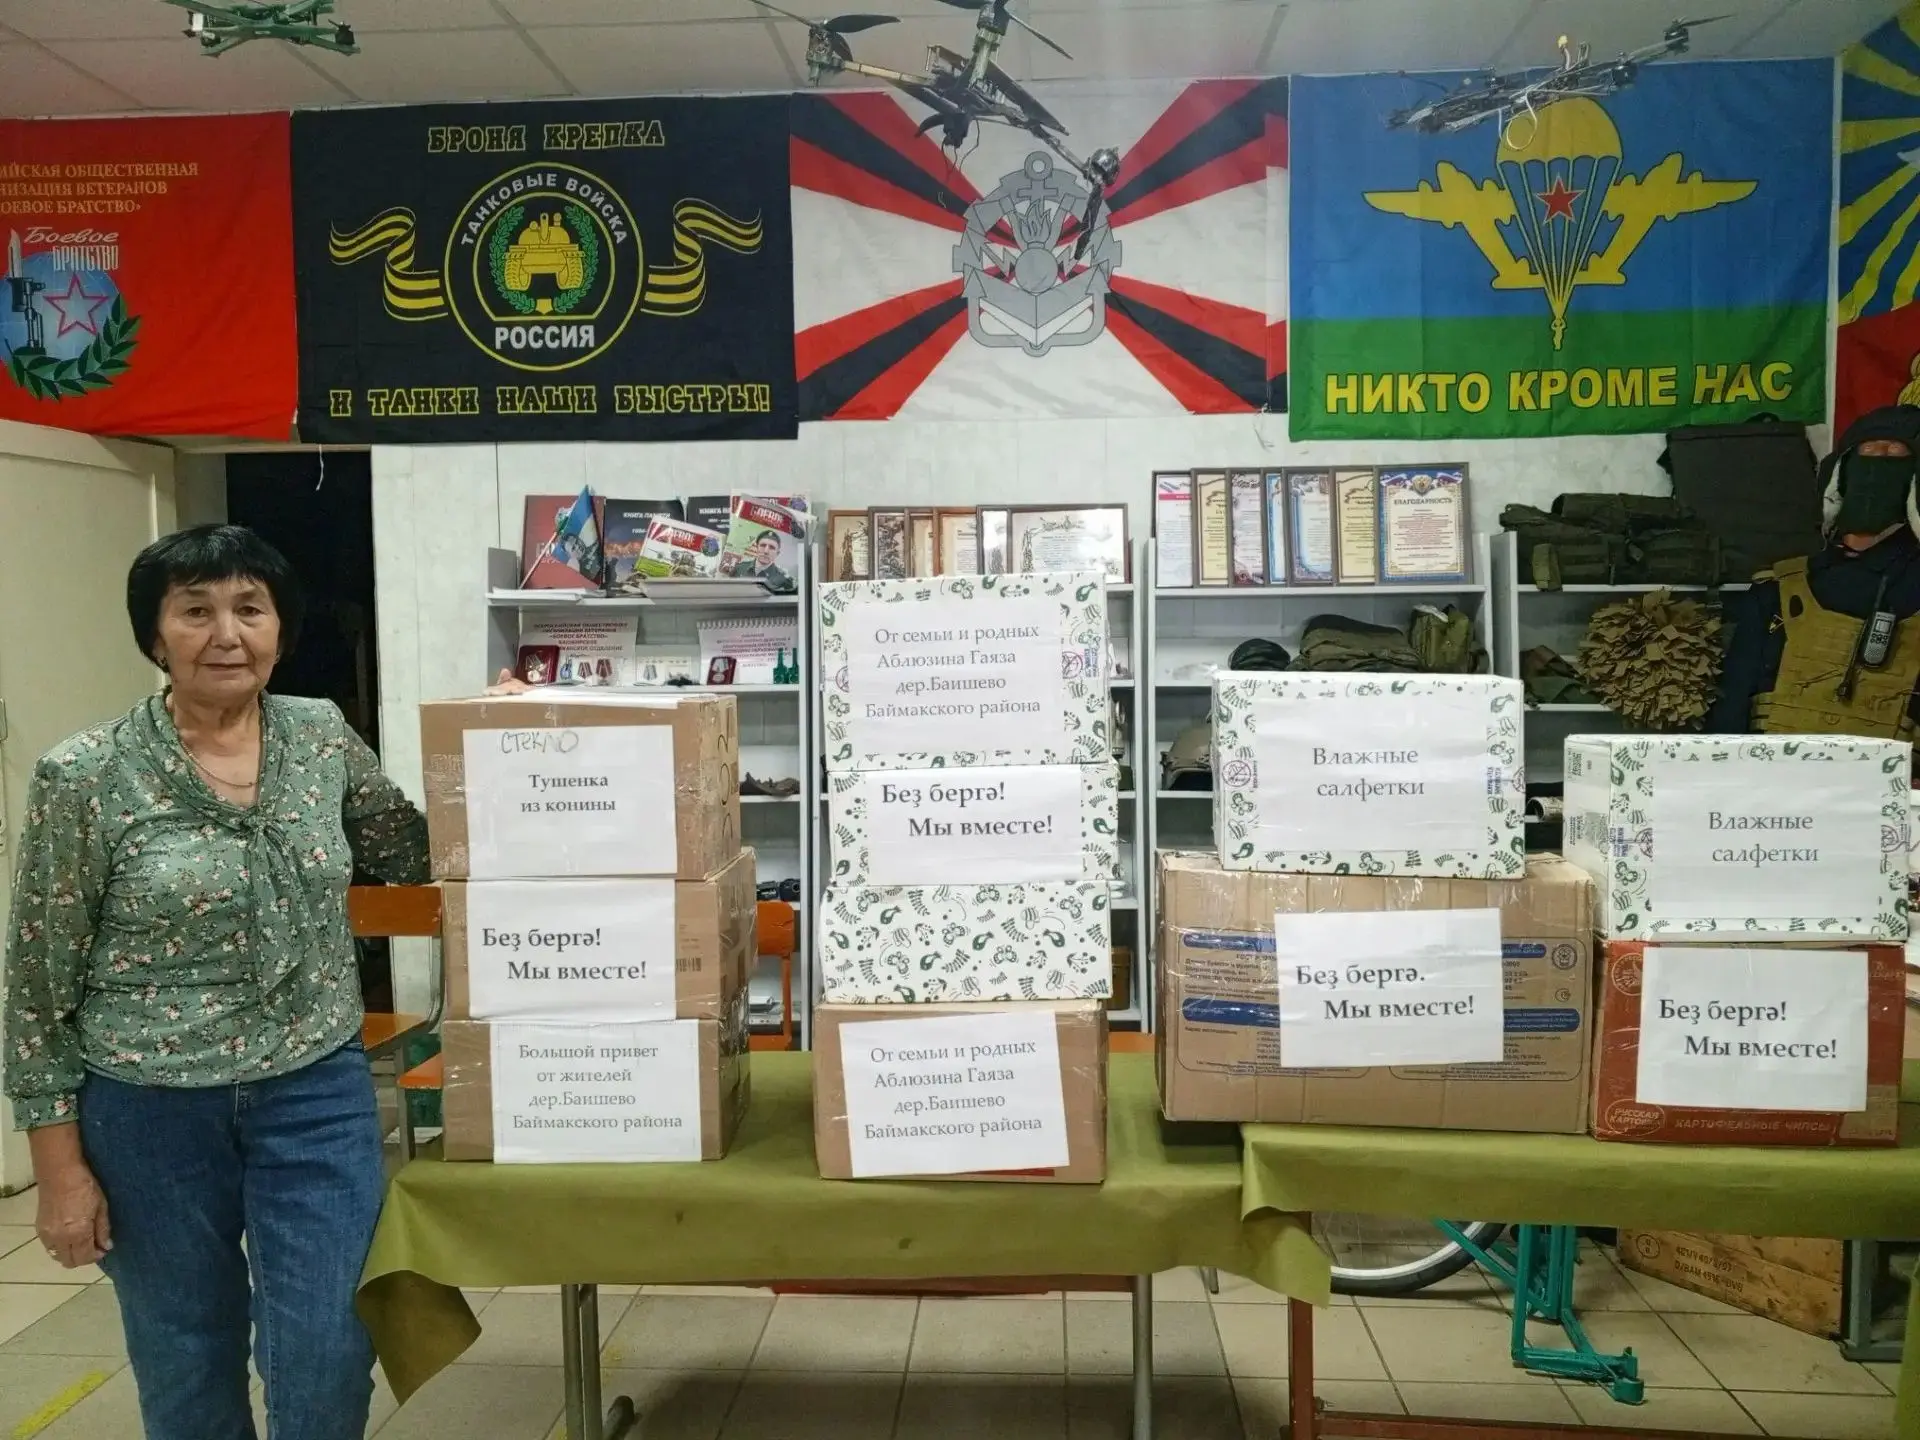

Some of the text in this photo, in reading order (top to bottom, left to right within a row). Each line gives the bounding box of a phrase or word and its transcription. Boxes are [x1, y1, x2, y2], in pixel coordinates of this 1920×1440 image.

[428, 120, 665, 152] БРОНЯ КРЕПКА
[65, 163, 199, 178] ОБЩЕСТВЕННАЯ
[76, 180, 168, 195] ВЕТЕРАНОВ
[57, 200, 141, 214] БРАТСТВО»
[461, 173, 628, 246] ТАНКОВЫЕ ВОЙСКА
[24, 226, 119, 243] Боевое
[53, 245, 119, 271] БРАТСТВО
[494, 324, 595, 349] РОССИЯ
[1325, 361, 1793, 414] НИКТО КРОМЕ НАС
[329, 384, 770, 416] И ТАНКИ НАШИ БЫСТРЫ!
[875, 627, 1039, 644] От семьи и родных
[877, 650, 1015, 668] Аблюзина Гаяза
[896, 677, 1006, 696] дер.Баишево
[866, 700, 1040, 718] Баймакского района
[1312, 748, 1418, 765] Влажные
[528, 775, 608, 792] Тушенка
[1317, 778, 1424, 801] салфетки
[883, 782, 1004, 807] Беҙ бергә!
[522, 801, 615, 812] из конины
[910, 815, 1051, 836] Мы вместе!
[1710, 812, 1813, 829] Влажные
[1713, 844, 1818, 868] салфетки
[483, 928, 600, 952] Беҙ бергә!
[508, 961, 645, 979] Мы вместе!
[1297, 966, 1338, 989] Беҙ
[1347, 965, 1424, 988] бергә.
[1325, 995, 1473, 1018] Мы вместе!
[1660, 999, 1786, 1026] Беҙ бергә!
[519, 1045, 658, 1062] Большой привет
[871, 1042, 1036, 1062] От семьи и родных
[1686, 1036, 1836, 1058] Мы вместе!
[537, 1069, 632, 1081] от жителей
[875, 1068, 1014, 1088] Аблюзина Гаяза
[529, 1091, 635, 1110] дер.Баишево
[894, 1096, 1005, 1116] дер.Баишево
[513, 1116, 682, 1132] Баймакского района
[865, 1118, 1041, 1138] Баймакского района
